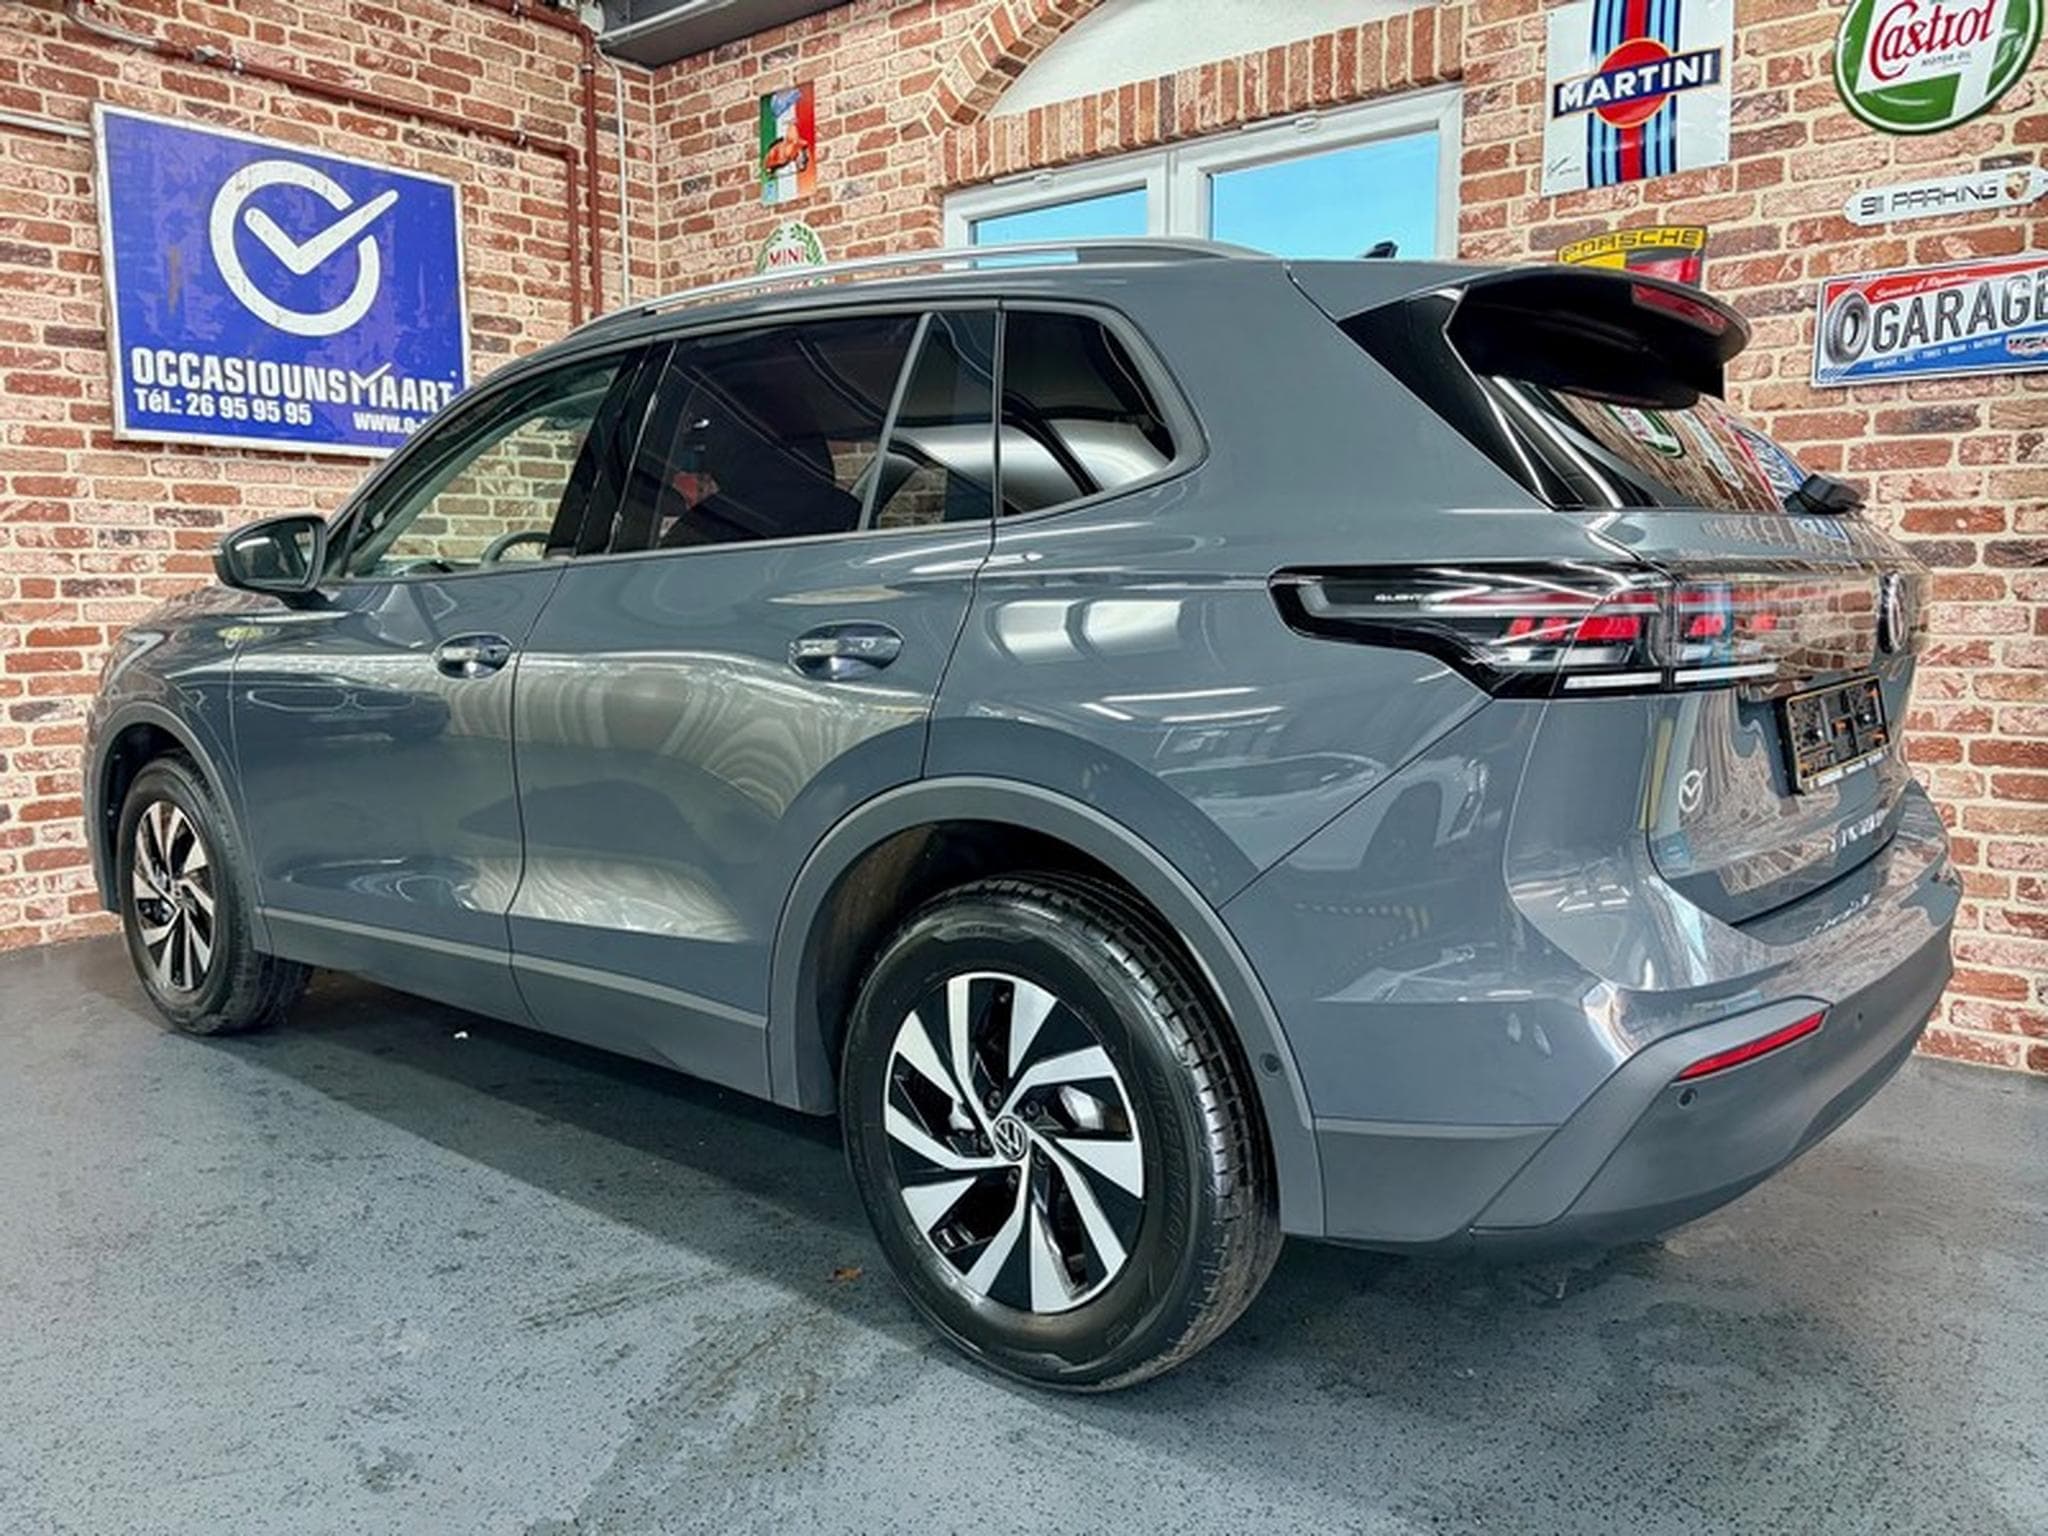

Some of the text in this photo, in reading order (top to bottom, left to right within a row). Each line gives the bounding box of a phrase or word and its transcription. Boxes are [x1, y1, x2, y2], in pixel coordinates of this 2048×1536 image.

[1869, 0, 1994, 81] Castrol
[1558, 53, 1713, 112] MARTINI
[1892, 179, 1999, 212] PARKING
[768, 246, 805, 265] MINI
[1561, 229, 1699, 262] PORSCHE
[1871, 270, 2048, 354] GARAGE
[131, 347, 454, 414] OCCASIOUNSMAART
[187, 393, 215, 416] 26
[219, 396, 248, 420] 95
[253, 399, 280, 423] 95
[285, 402, 312, 426] 95
